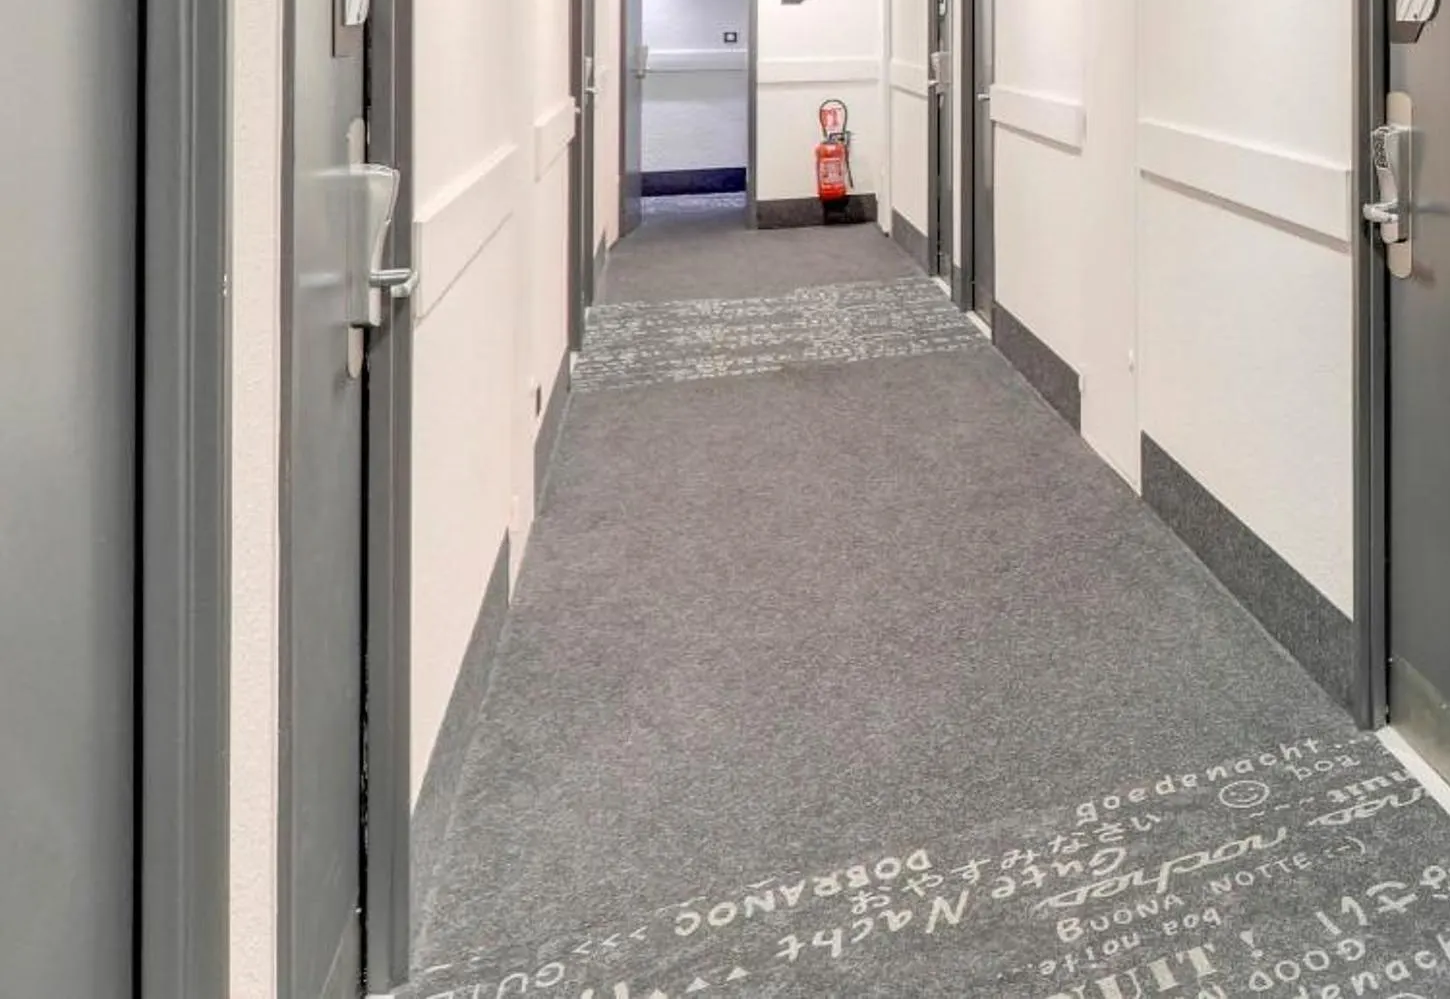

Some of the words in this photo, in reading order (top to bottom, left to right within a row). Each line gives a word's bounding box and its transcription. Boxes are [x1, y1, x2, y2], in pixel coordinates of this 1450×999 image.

[674, 849, 933, 937] DOBRANOC
[991, 848, 1126, 900] Gute
[1210, 852, 1312, 895] NOTTE
[776, 890, 969, 962] Nacht
[1249, 938, 1366, 993] GOOD
